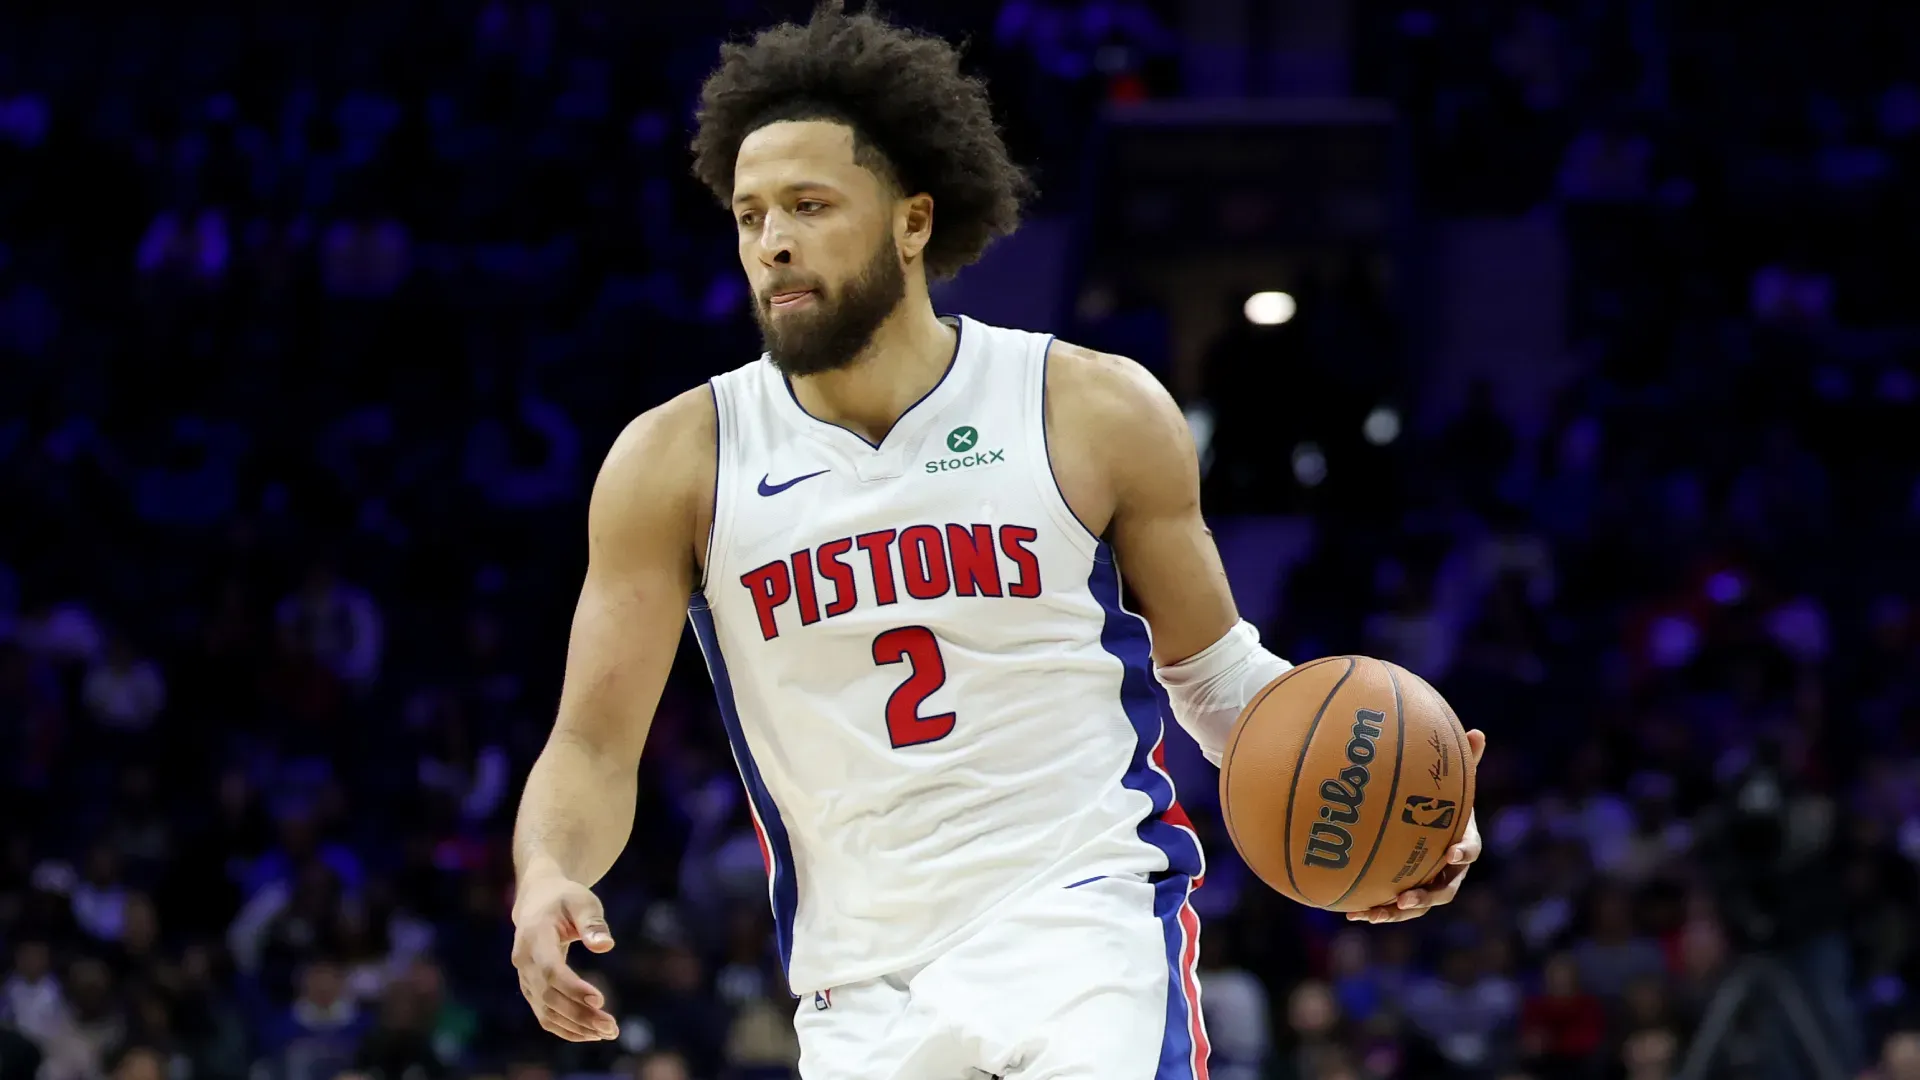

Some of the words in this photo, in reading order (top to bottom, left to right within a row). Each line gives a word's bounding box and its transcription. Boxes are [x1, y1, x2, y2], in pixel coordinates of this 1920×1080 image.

[740, 523, 1042, 641] PISTONS
[872, 625, 956, 749] 2
[1303, 708, 1386, 870] Wilson
